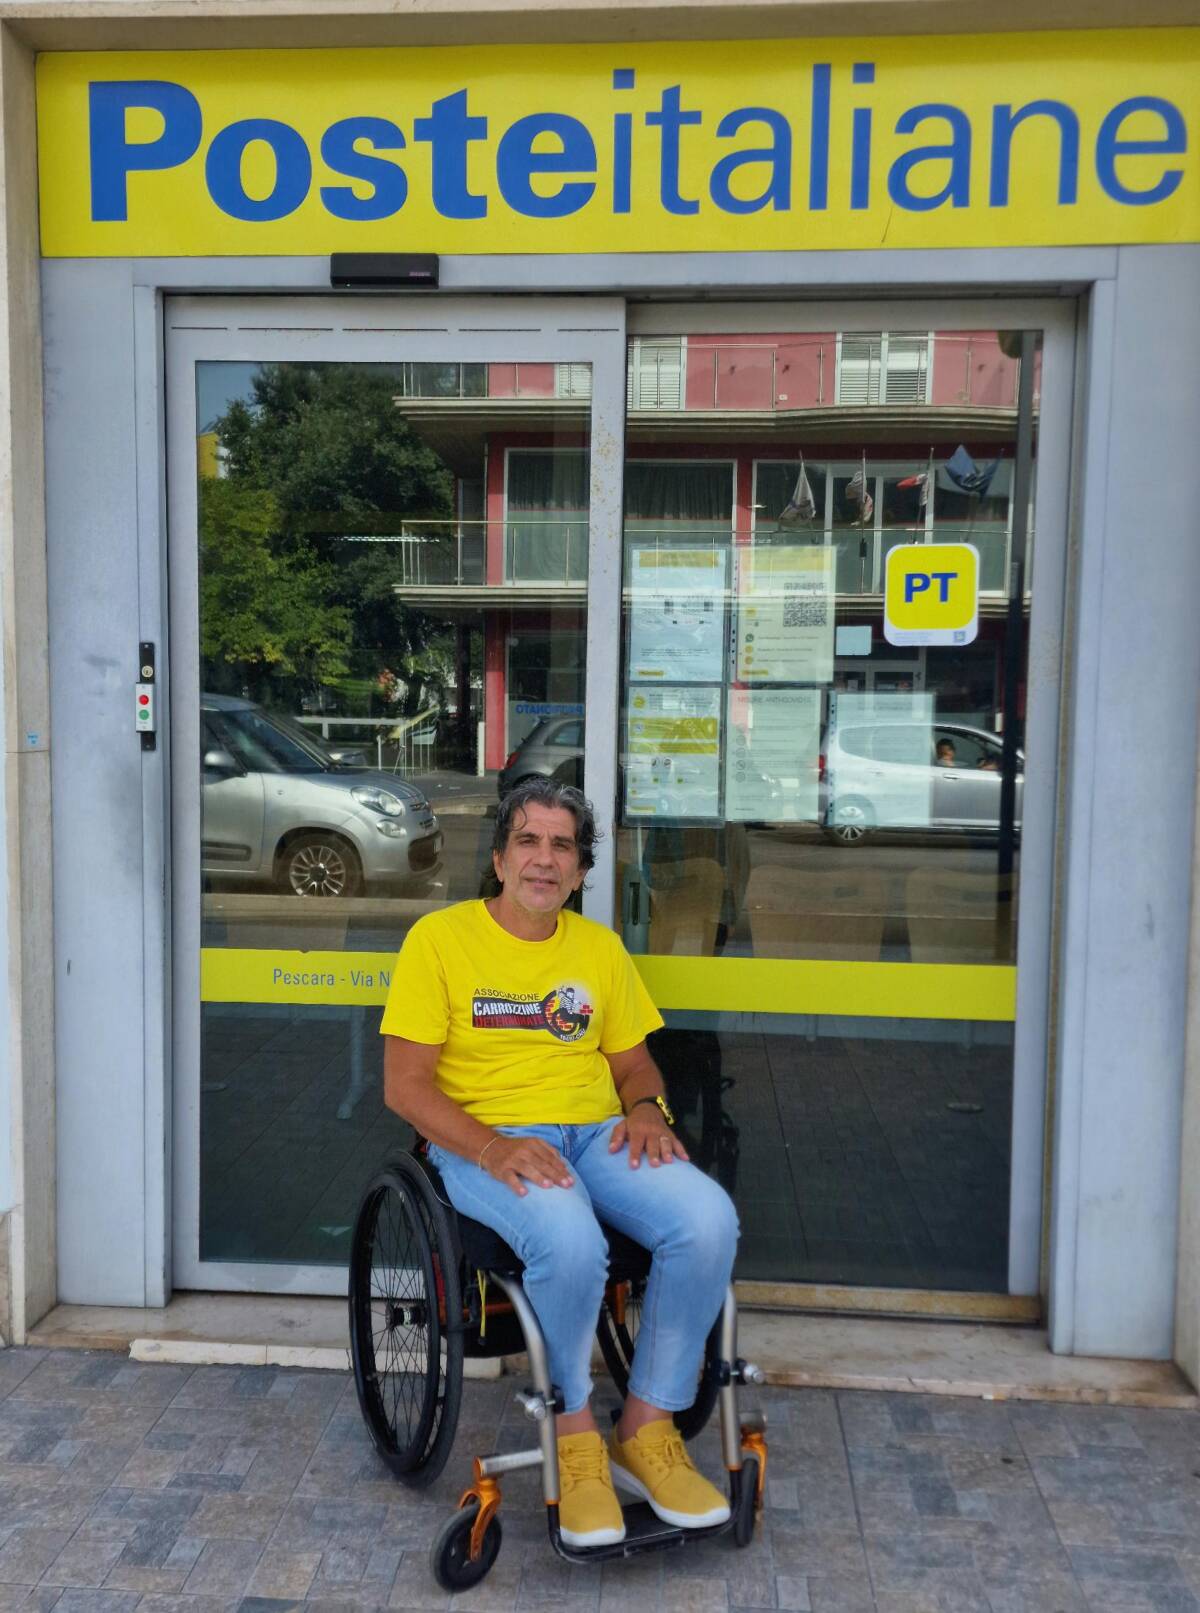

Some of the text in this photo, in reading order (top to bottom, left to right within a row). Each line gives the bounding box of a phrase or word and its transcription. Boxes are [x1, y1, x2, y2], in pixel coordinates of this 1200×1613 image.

[904, 572, 958, 603] PT
[273, 968, 335, 986] Pescara
[350, 970, 373, 987] Via
[473, 988, 540, 1001] ASSOCIAZIONE
[473, 1002, 542, 1016] CARROZZINE
